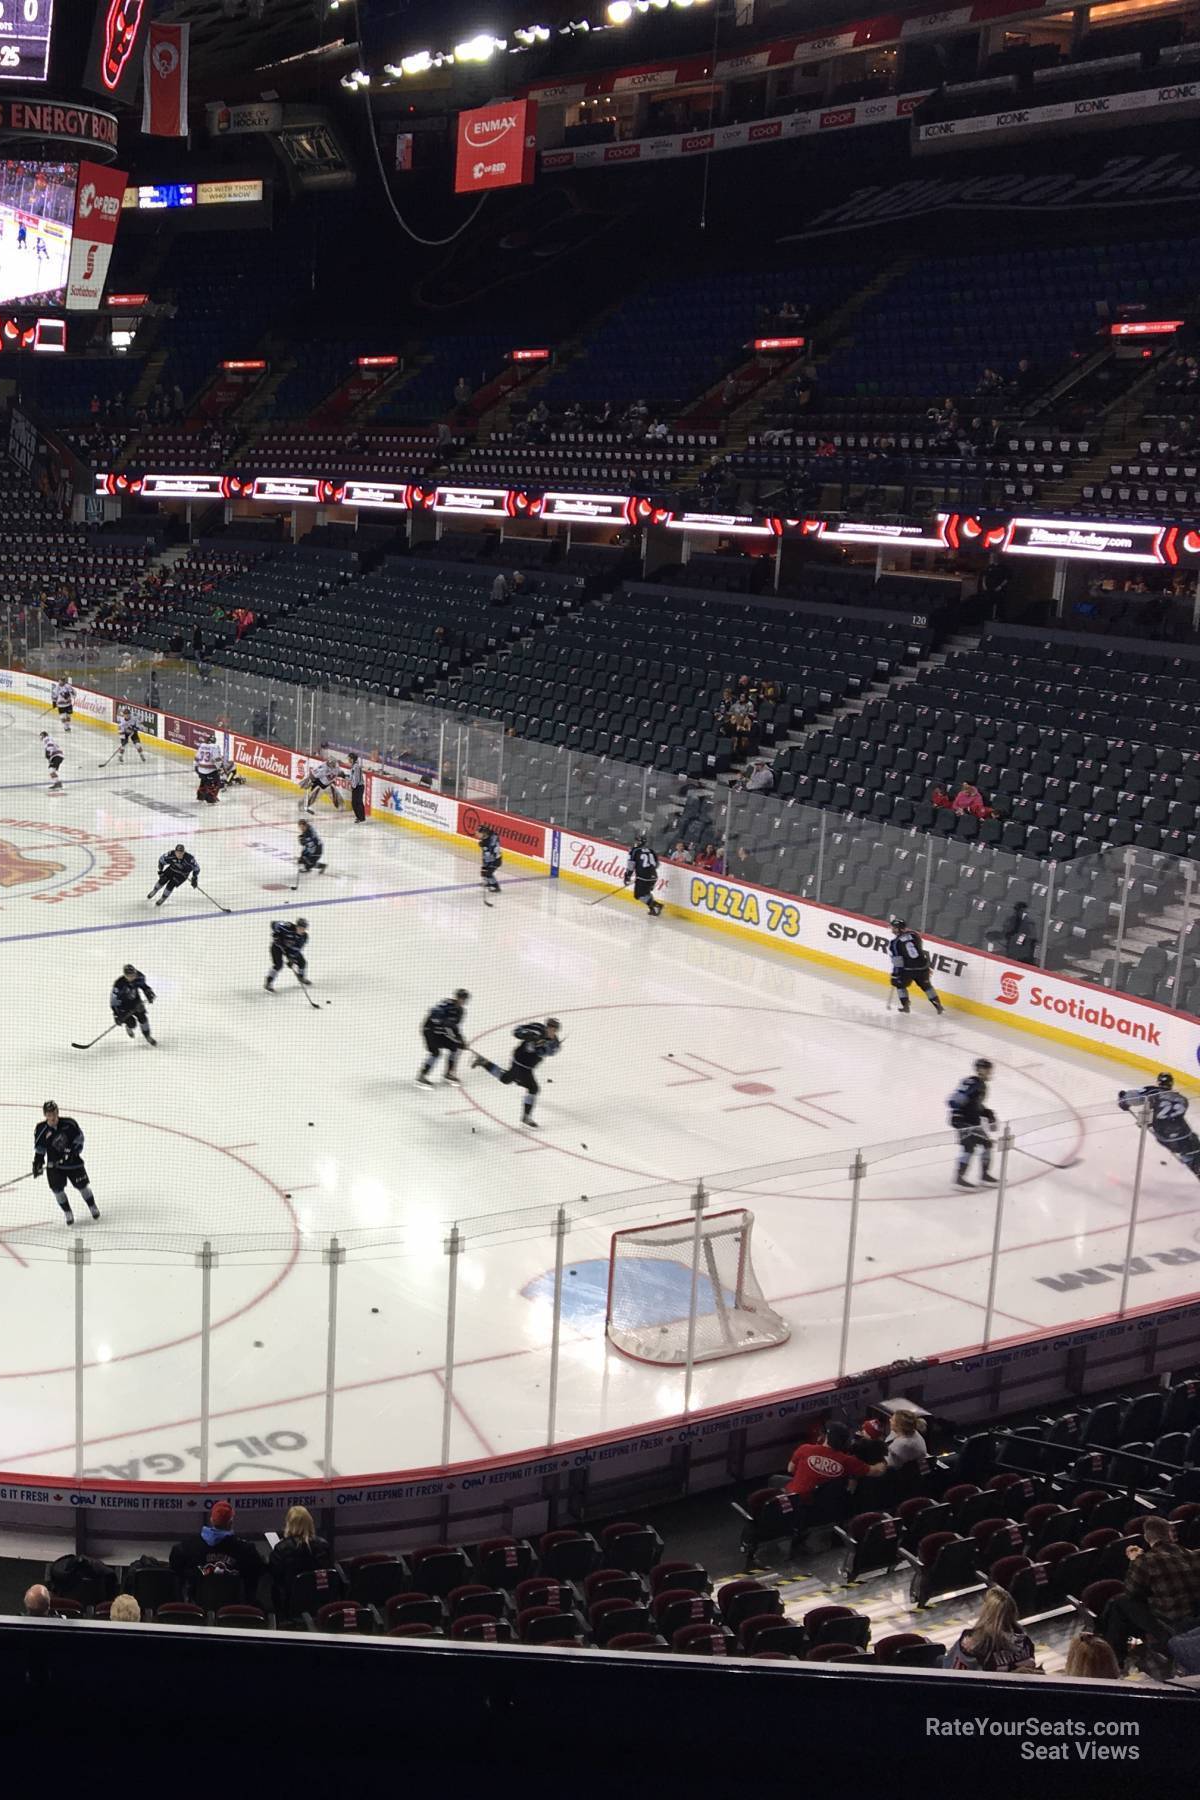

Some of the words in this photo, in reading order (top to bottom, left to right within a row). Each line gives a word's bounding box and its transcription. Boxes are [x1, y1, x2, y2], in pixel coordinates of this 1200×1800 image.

[1158, 85, 1197, 102] ICONIC
[1074, 99, 1111, 115] ICONIC
[11, 104, 89, 136] ENERGY
[233, 118, 270, 127] HOCKEY
[473, 115, 517, 134] ENMAX
[996, 112, 1030, 126] ICONIC
[925, 123, 955, 137] ICONIC
[94, 199, 103, 210] OF
[102, 197, 119, 215] RED
[70, 284, 98, 298] Scotiabank
[235, 741, 252, 766] Tim
[252, 745, 289, 776] Hortons
[412, 792, 438, 813] Chesney
[691, 877, 760, 925] PIZZA
[767, 899, 801, 937] 73
[1030, 986, 1162, 1046] Scotiabank
[701, 1419, 731, 1435] KEEPING
[732, 1418, 739, 1429] IT
[740, 1412, 764, 1426] FRESH
[215, 1431, 308, 1458] OIL
[489, 1469, 522, 1486] KEEPING
[524, 1468, 533, 1479] IT
[534, 1462, 558, 1476] FRESH
[812, 1457, 838, 1473] PRO
[9, 1487, 18, 1499] IT
[20, 1489, 49, 1503] FRESH
[70, 1493, 96, 1506] OPA!
[100, 1495, 139, 1509] KEEPING
[142, 1497, 150, 1509] IT
[151, 1497, 183, 1509] FRESH
[235, 1496, 273, 1509] KEEPING
[275, 1496, 283, 1508] IT
[287, 1495, 316, 1508] FRESH
[337, 1492, 364, 1505] OPA!
[366, 1486, 403, 1502] KEEPING
[404, 1486, 415, 1499] IT
[416, 1482, 443, 1496] FRESH
